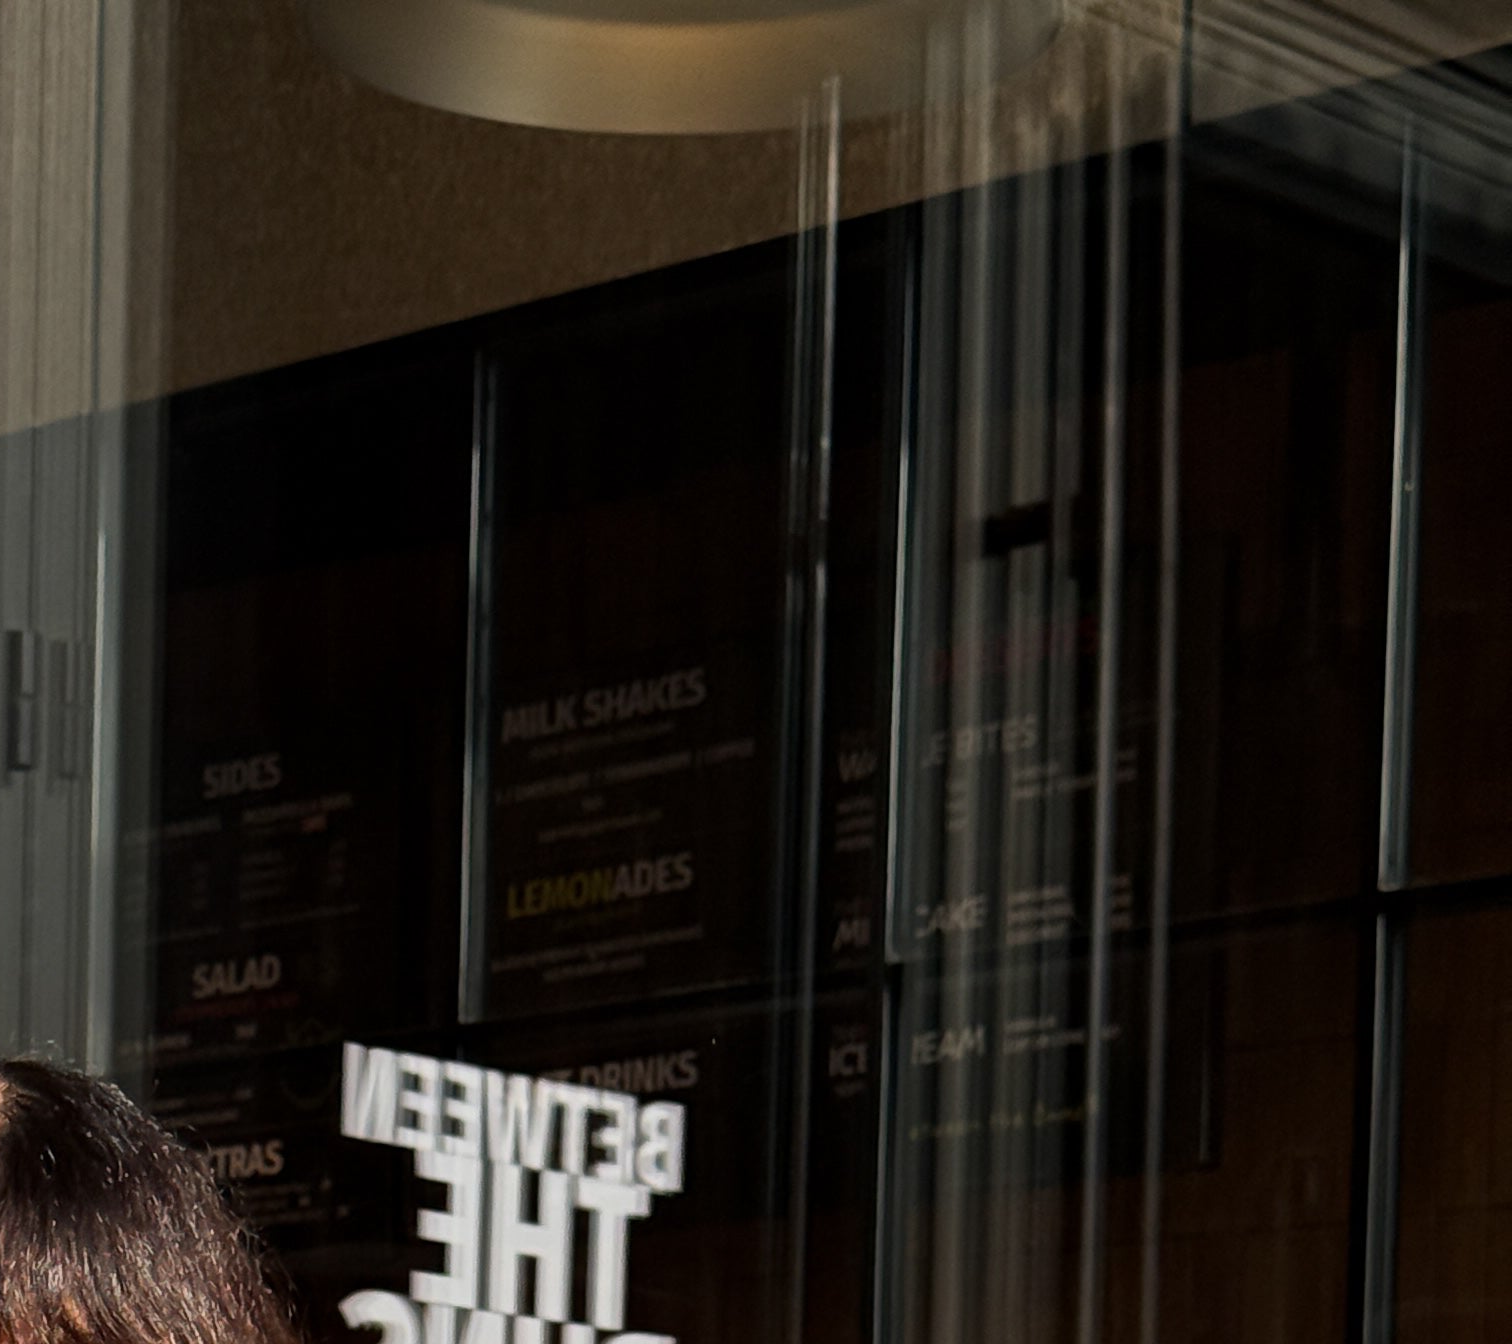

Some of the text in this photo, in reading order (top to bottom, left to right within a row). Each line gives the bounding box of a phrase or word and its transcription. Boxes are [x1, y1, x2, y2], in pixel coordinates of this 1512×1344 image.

[202, 751, 284, 801] SIDES
[506, 850, 695, 920] LEMONADES
[193, 952, 283, 1000] SALAD
[210, 1138, 286, 1179] TRAS
